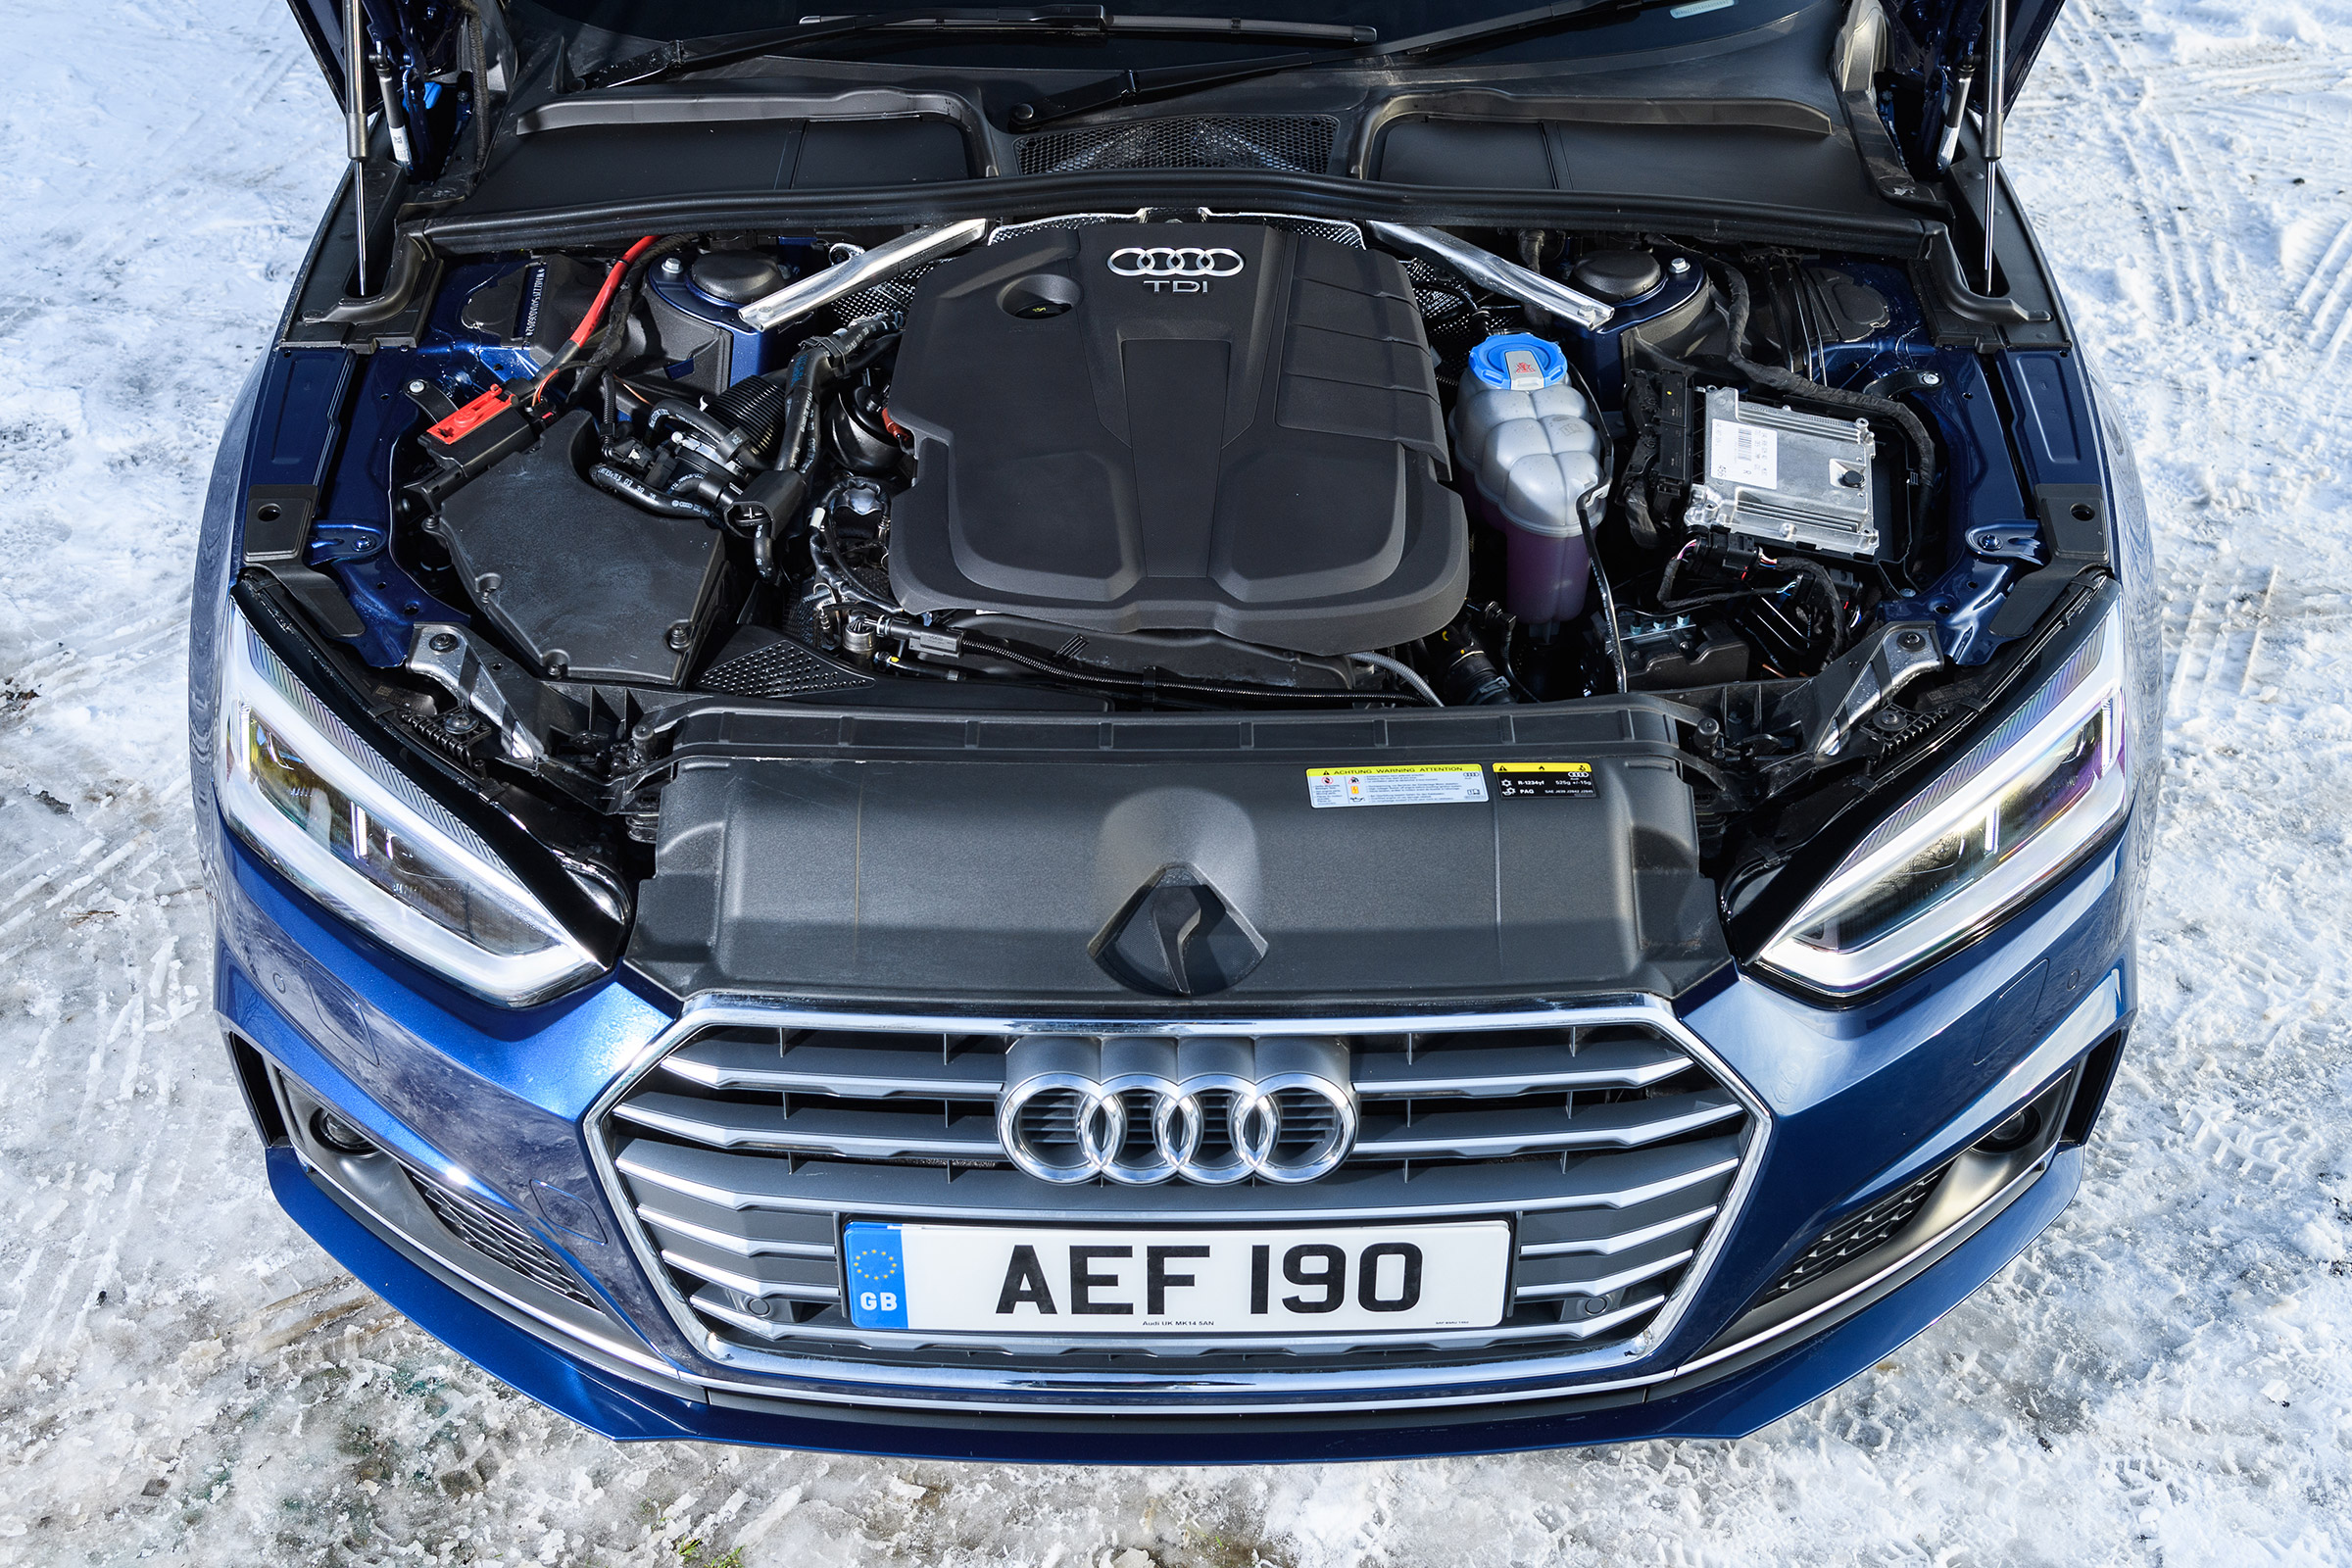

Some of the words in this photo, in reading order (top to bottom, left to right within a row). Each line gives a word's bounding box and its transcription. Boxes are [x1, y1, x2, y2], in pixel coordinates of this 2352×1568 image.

[1143, 280, 1207, 293] TDI
[995, 1245, 1210, 1315] AEF
[1250, 1242, 1423, 1315] 190
[859, 1292, 898, 1311] GB
